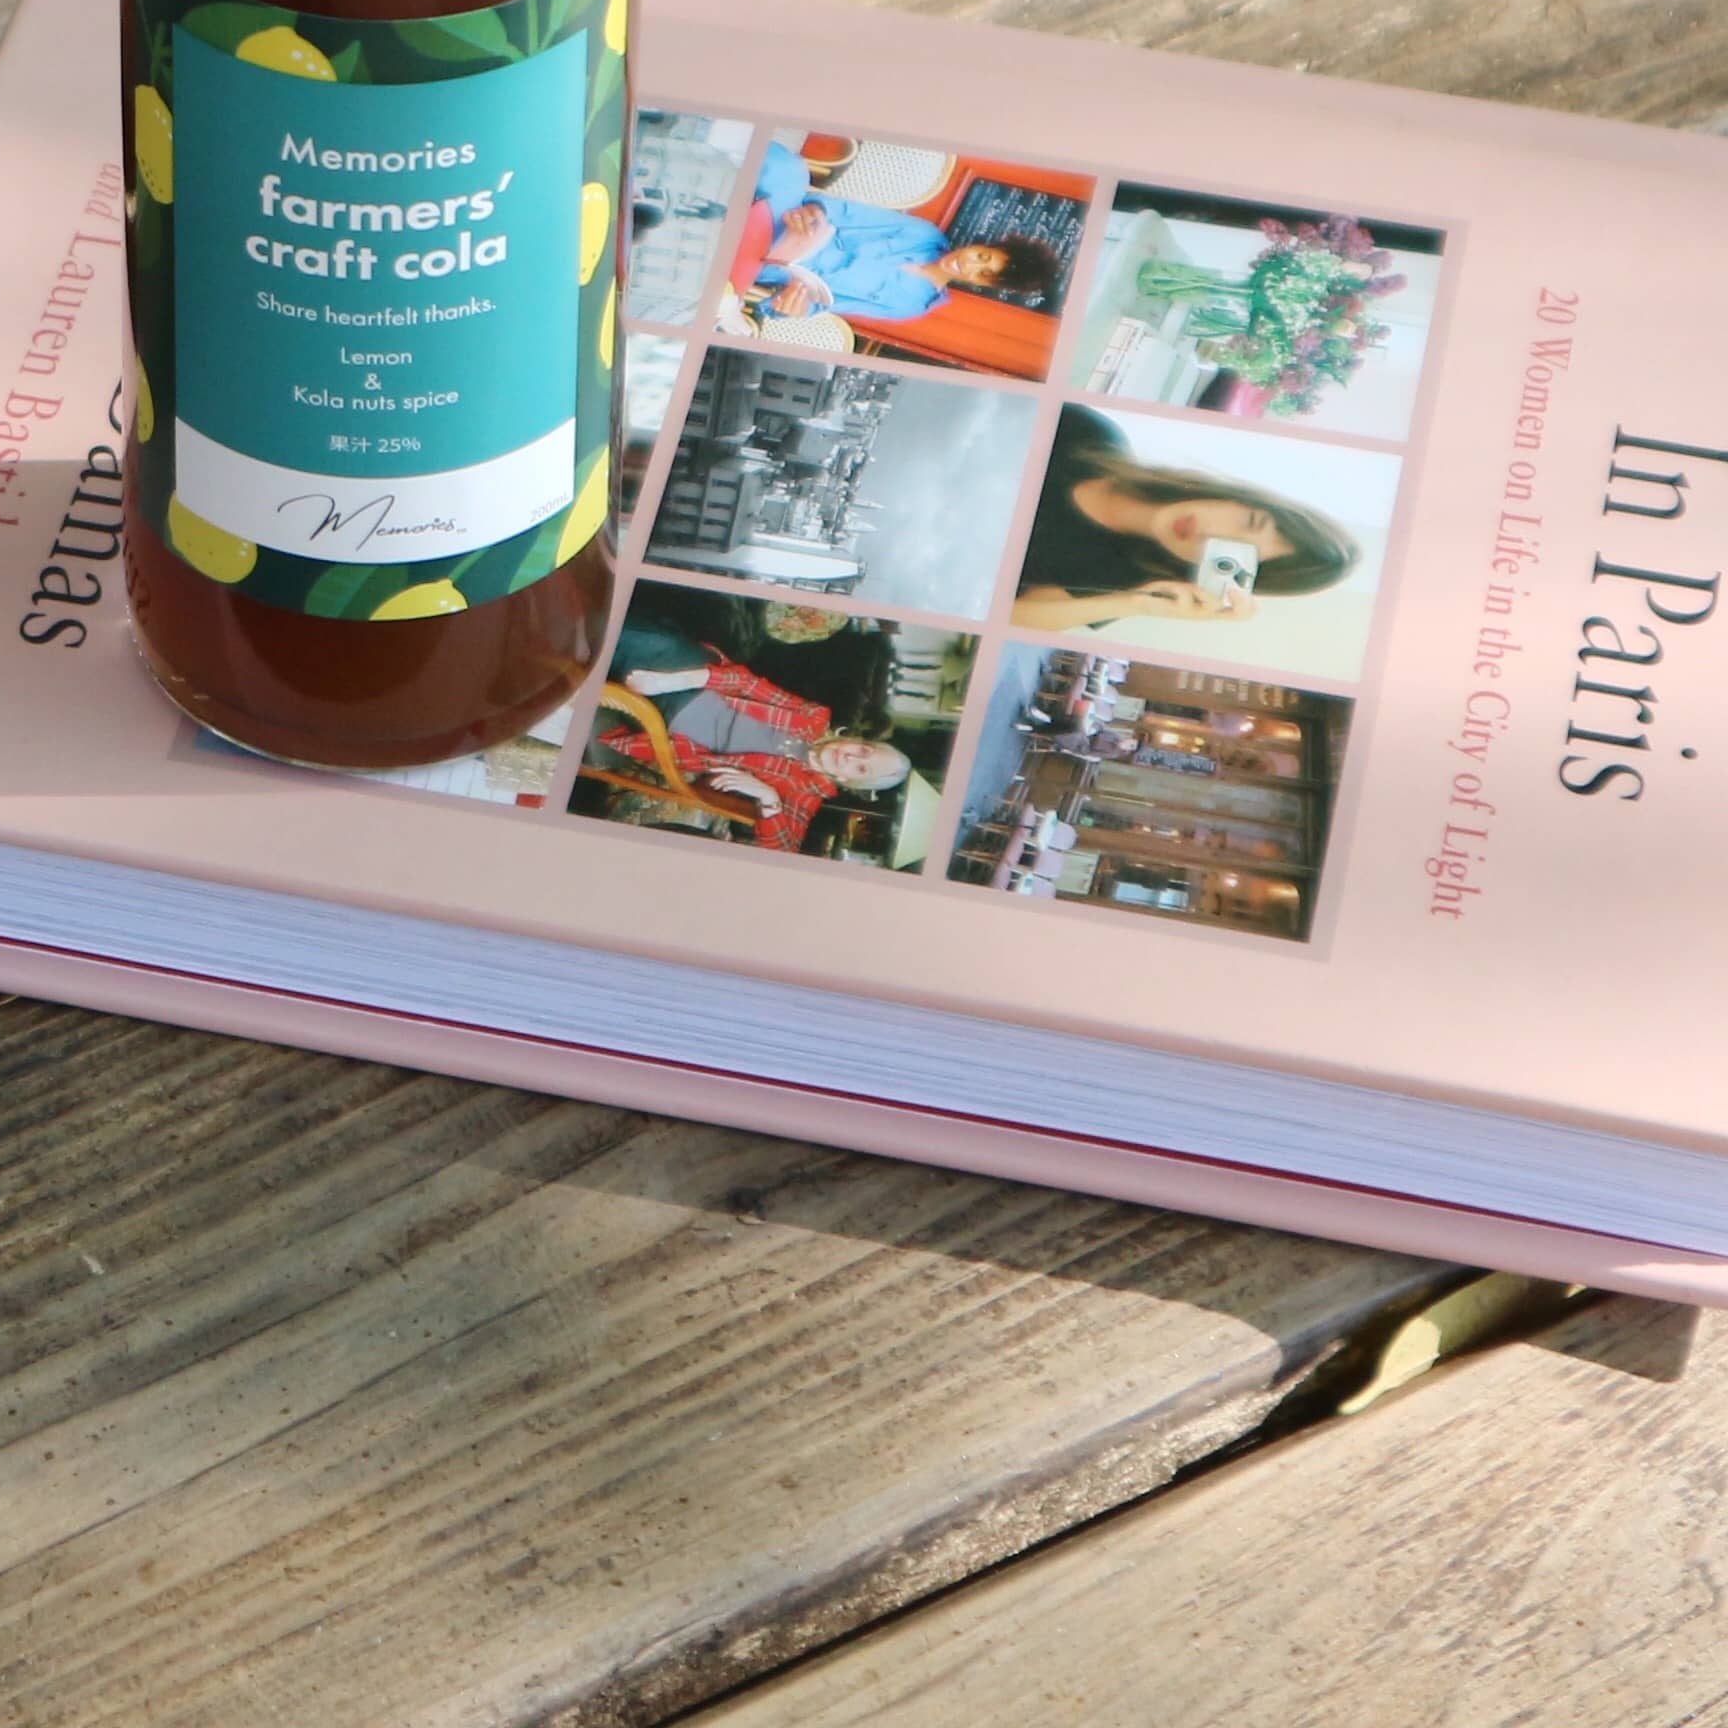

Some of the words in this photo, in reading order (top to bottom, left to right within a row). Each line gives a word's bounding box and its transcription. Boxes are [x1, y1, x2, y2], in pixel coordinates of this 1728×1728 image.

[281, 133, 476, 172] Memories
[246, 234, 378, 280] craft
[394, 231, 507, 280] cola
[19, 230, 122, 378] Lauren
[257, 292, 318, 322] Share
[325, 304, 419, 328] heartfelt
[424, 297, 497, 323] thanks.
[1536, 285, 1579, 326] 20
[341, 346, 413, 366] Lemon
[293, 386, 344, 410] Kola
[352, 393, 396, 411] nuts
[402, 390, 460, 414] spice
[364, 373, 382, 391] &
[1513, 337, 1573, 449] Women
[329, 433, 371, 453] 果汁
[378, 436, 422, 453] 25%
[1504, 463, 1539, 503] on
[1602, 424, 1728, 520] In
[277, 494, 456, 552] Memories
[1492, 515, 1544, 574] Life
[1484, 587, 1532, 616] in
[1474, 628, 1522, 679] the
[1558, 550, 1723, 803] Paris
[1447, 692, 1512, 765] City
[1449, 774, 1496, 815] of
[1425, 821, 1489, 920] Light
